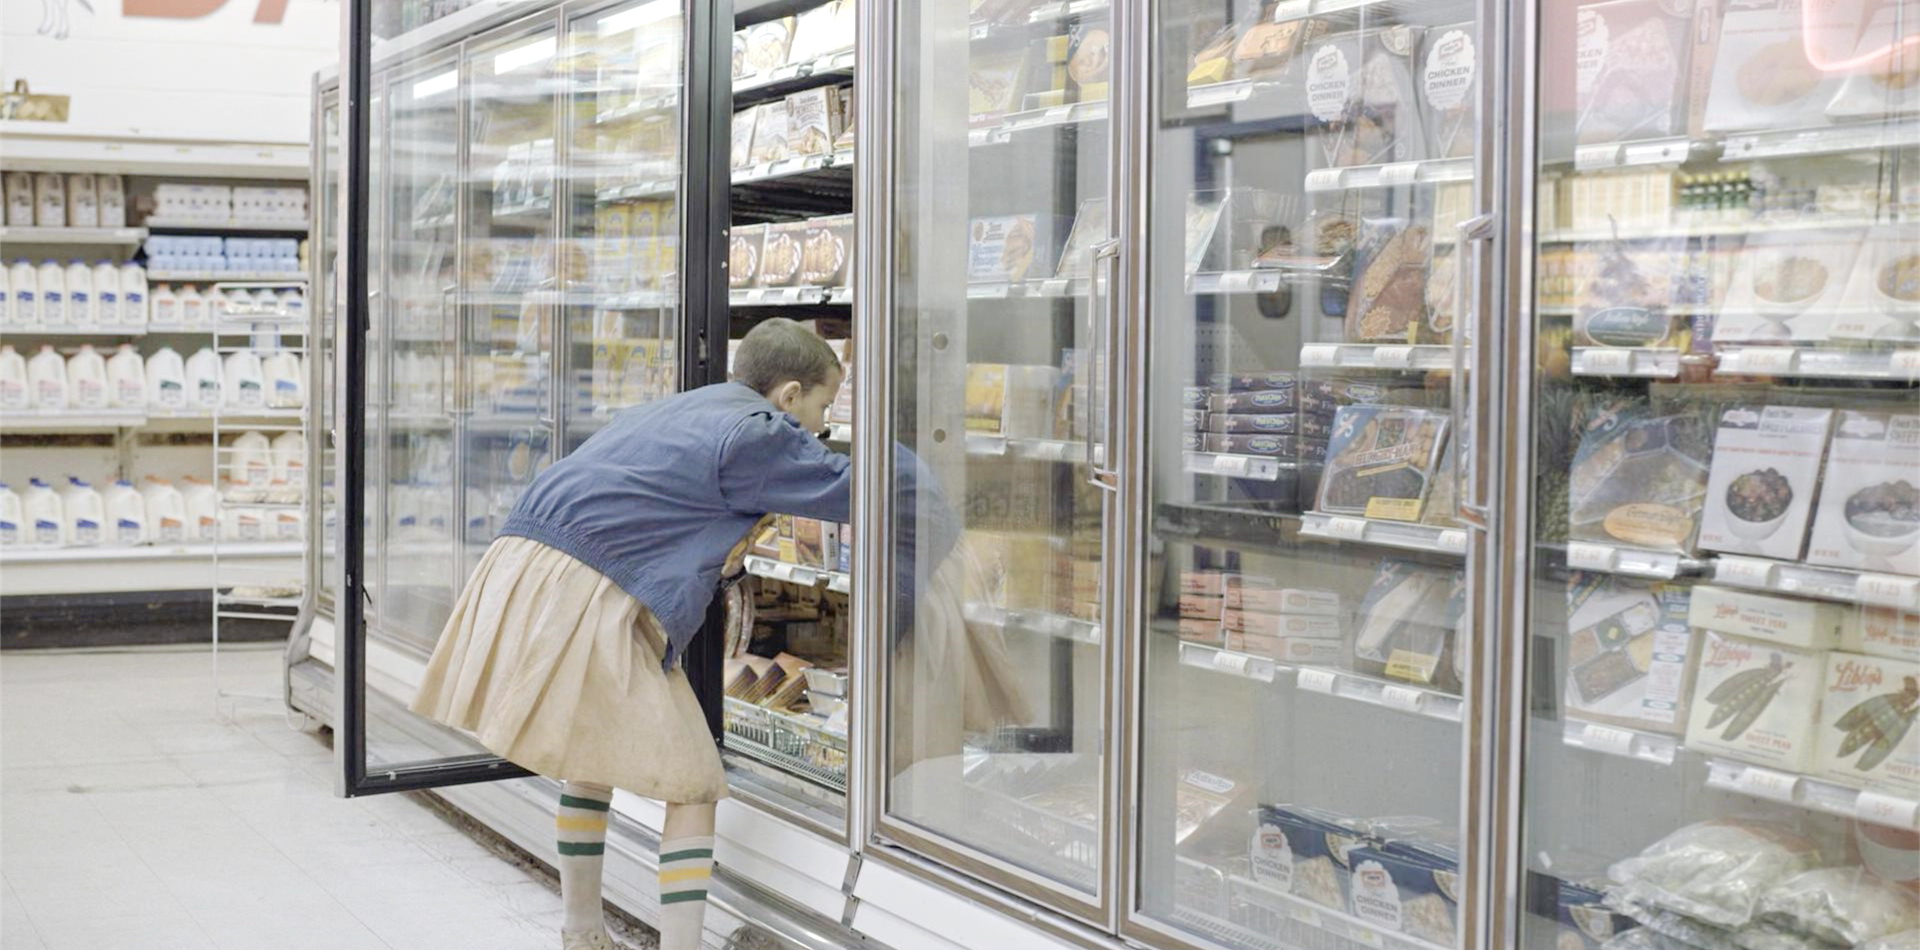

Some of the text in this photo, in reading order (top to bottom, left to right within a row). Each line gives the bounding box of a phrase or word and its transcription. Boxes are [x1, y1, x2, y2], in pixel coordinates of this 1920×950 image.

[1428, 66, 1470, 81] CHICKEN
[1309, 80, 1346, 92] CHICKEN
[1429, 77, 1466, 91] DINNER
[1311, 90, 1344, 102] DINNER
[1829, 660, 1883, 691] Libby's
[1253, 855, 1290, 874] CHICKEN
[1256, 866, 1288, 883] DINNER
[1356, 895, 1398, 913] CHICKEN
[1361, 905, 1397, 922] DINNER
